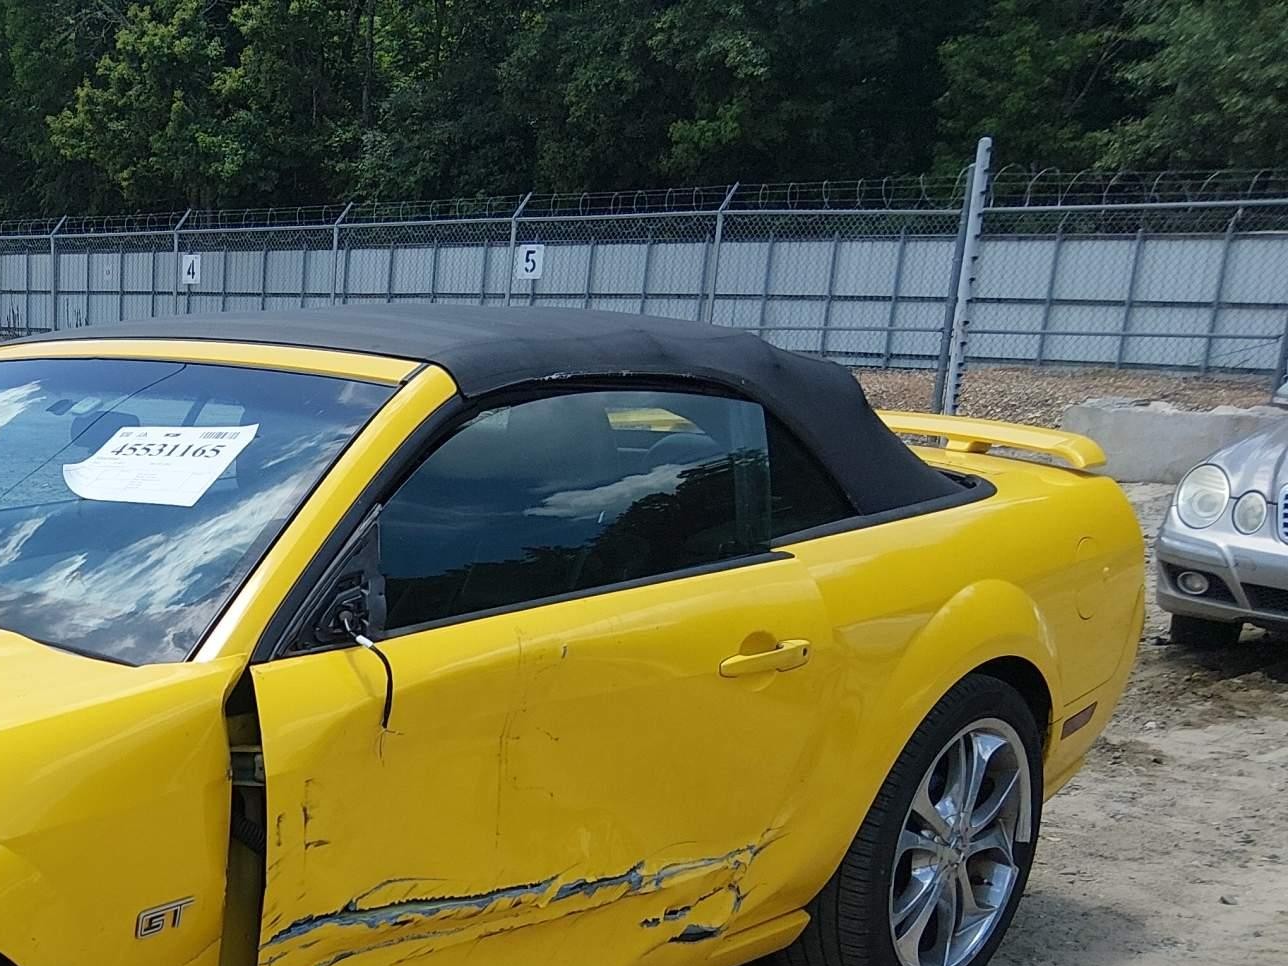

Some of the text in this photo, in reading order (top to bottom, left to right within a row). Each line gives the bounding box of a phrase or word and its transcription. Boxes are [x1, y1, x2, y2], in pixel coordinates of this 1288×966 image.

[187, 259, 195, 279] 4
[525, 250, 536, 273] 5
[111, 443, 226, 458] 45531165
[134, 895, 196, 940] GT
